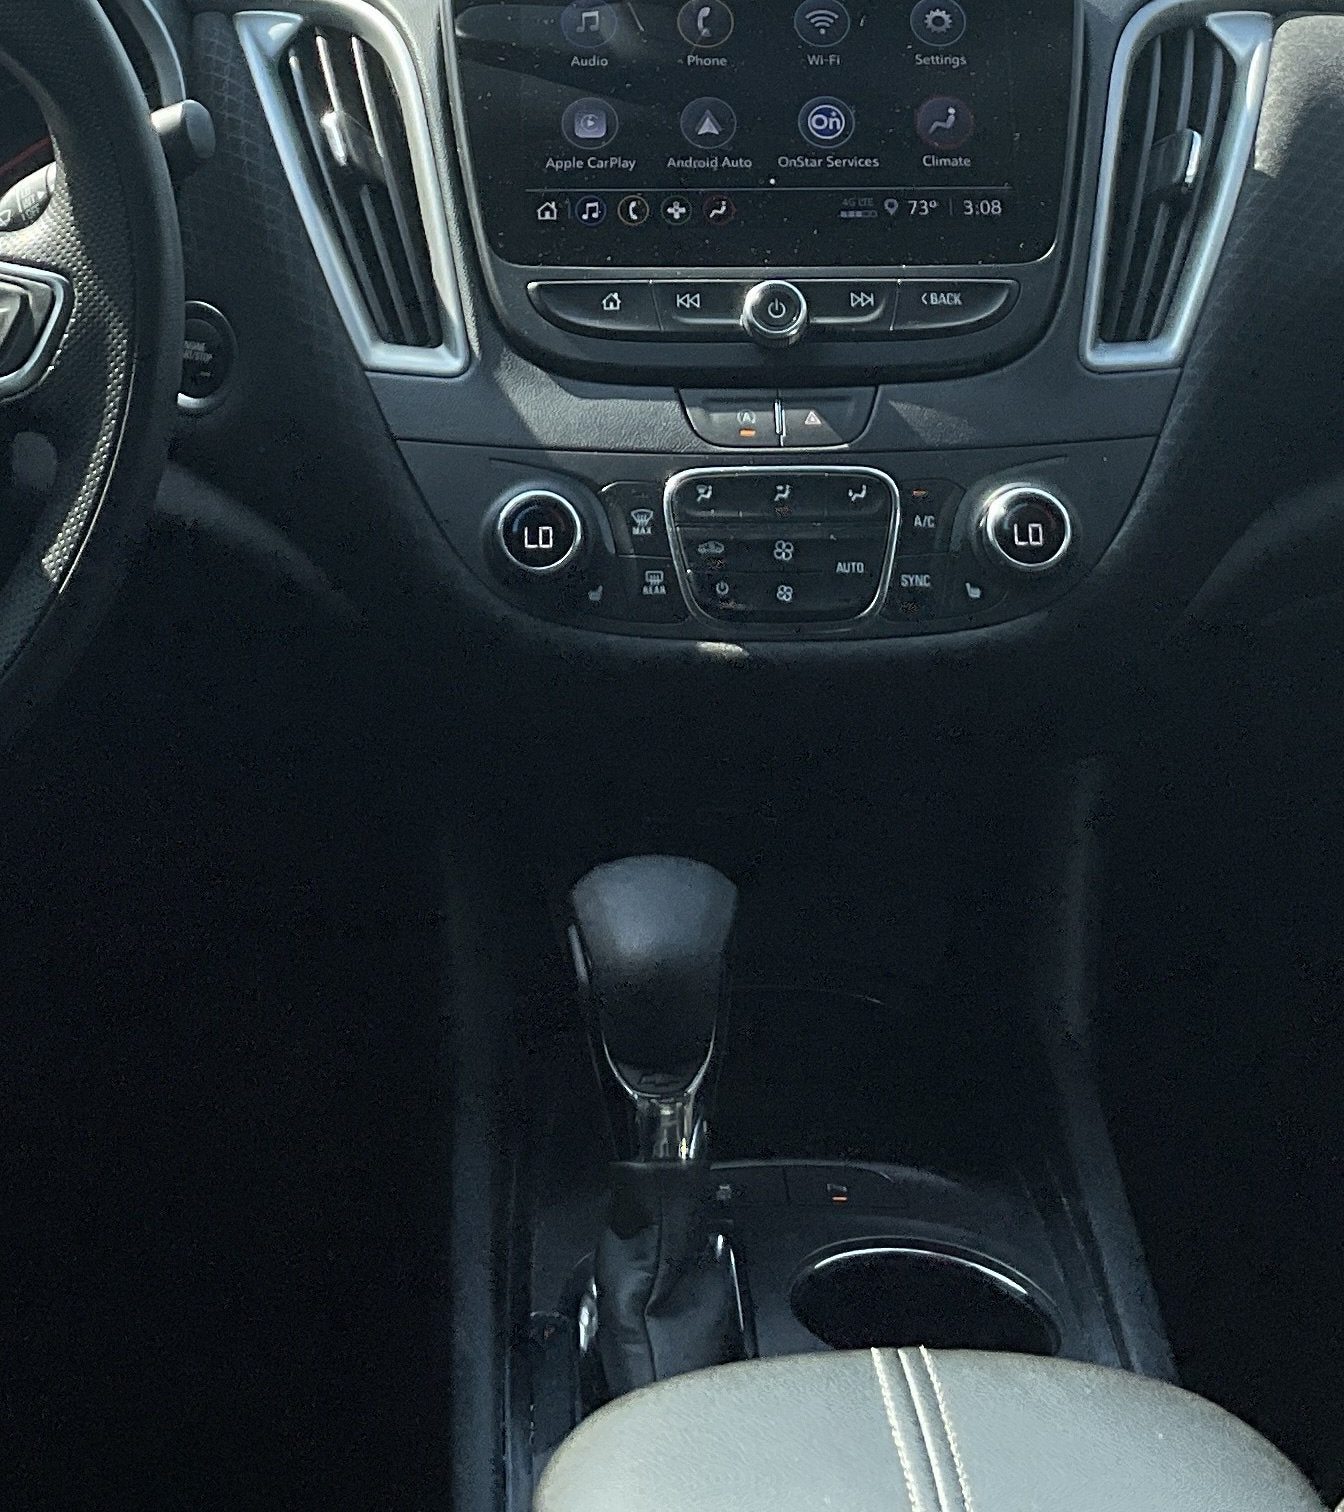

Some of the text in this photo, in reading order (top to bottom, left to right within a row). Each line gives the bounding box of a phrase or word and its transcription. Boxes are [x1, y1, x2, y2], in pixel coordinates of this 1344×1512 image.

[570, 55, 609, 67] Audio
[686, 54, 728, 67] Phone
[806, 54, 841, 67] Wi-Fi
[914, 53, 967, 70] Settings
[545, 156, 636, 172] Apple CarPlay
[666, 156, 754, 170] Android Auto
[777, 155, 881, 169] OnStar Services
[922, 155, 972, 168] Climate
[962, 199, 1003, 217] 3:08
[929, 292, 964, 306] BACK
[913, 515, 936, 529] A/C
[523, 525, 554, 549] LO
[1012, 522, 1045, 546] LO
[835, 561, 865, 575] AUTO
[900, 574, 933, 588] SYNC
